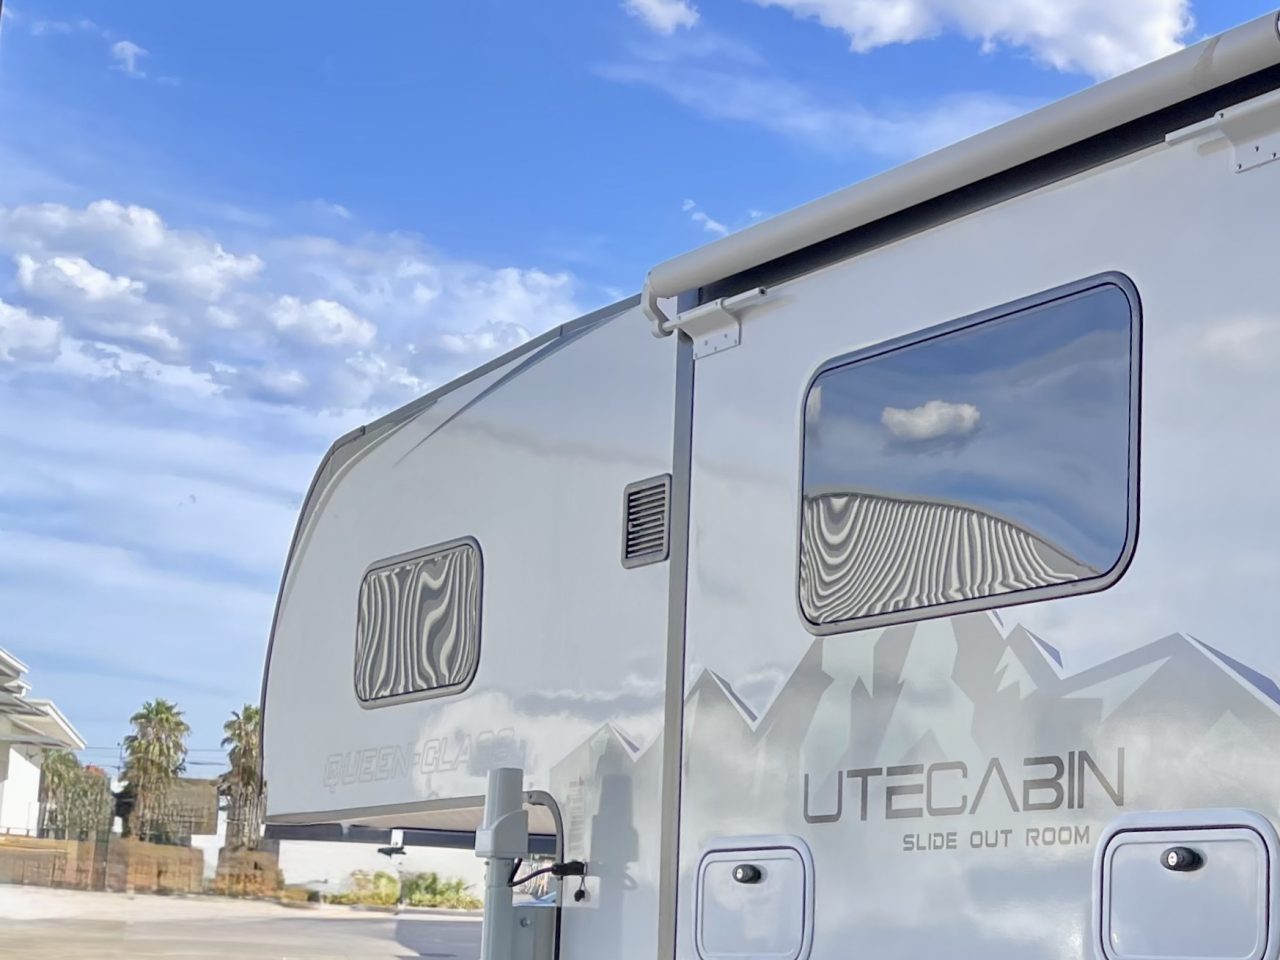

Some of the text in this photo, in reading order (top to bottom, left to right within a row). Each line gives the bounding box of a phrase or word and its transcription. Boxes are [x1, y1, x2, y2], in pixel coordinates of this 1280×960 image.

[803, 747, 1125, 824] UTECABIN
[903, 825, 1090, 851] SLIDE OUT ROOM
